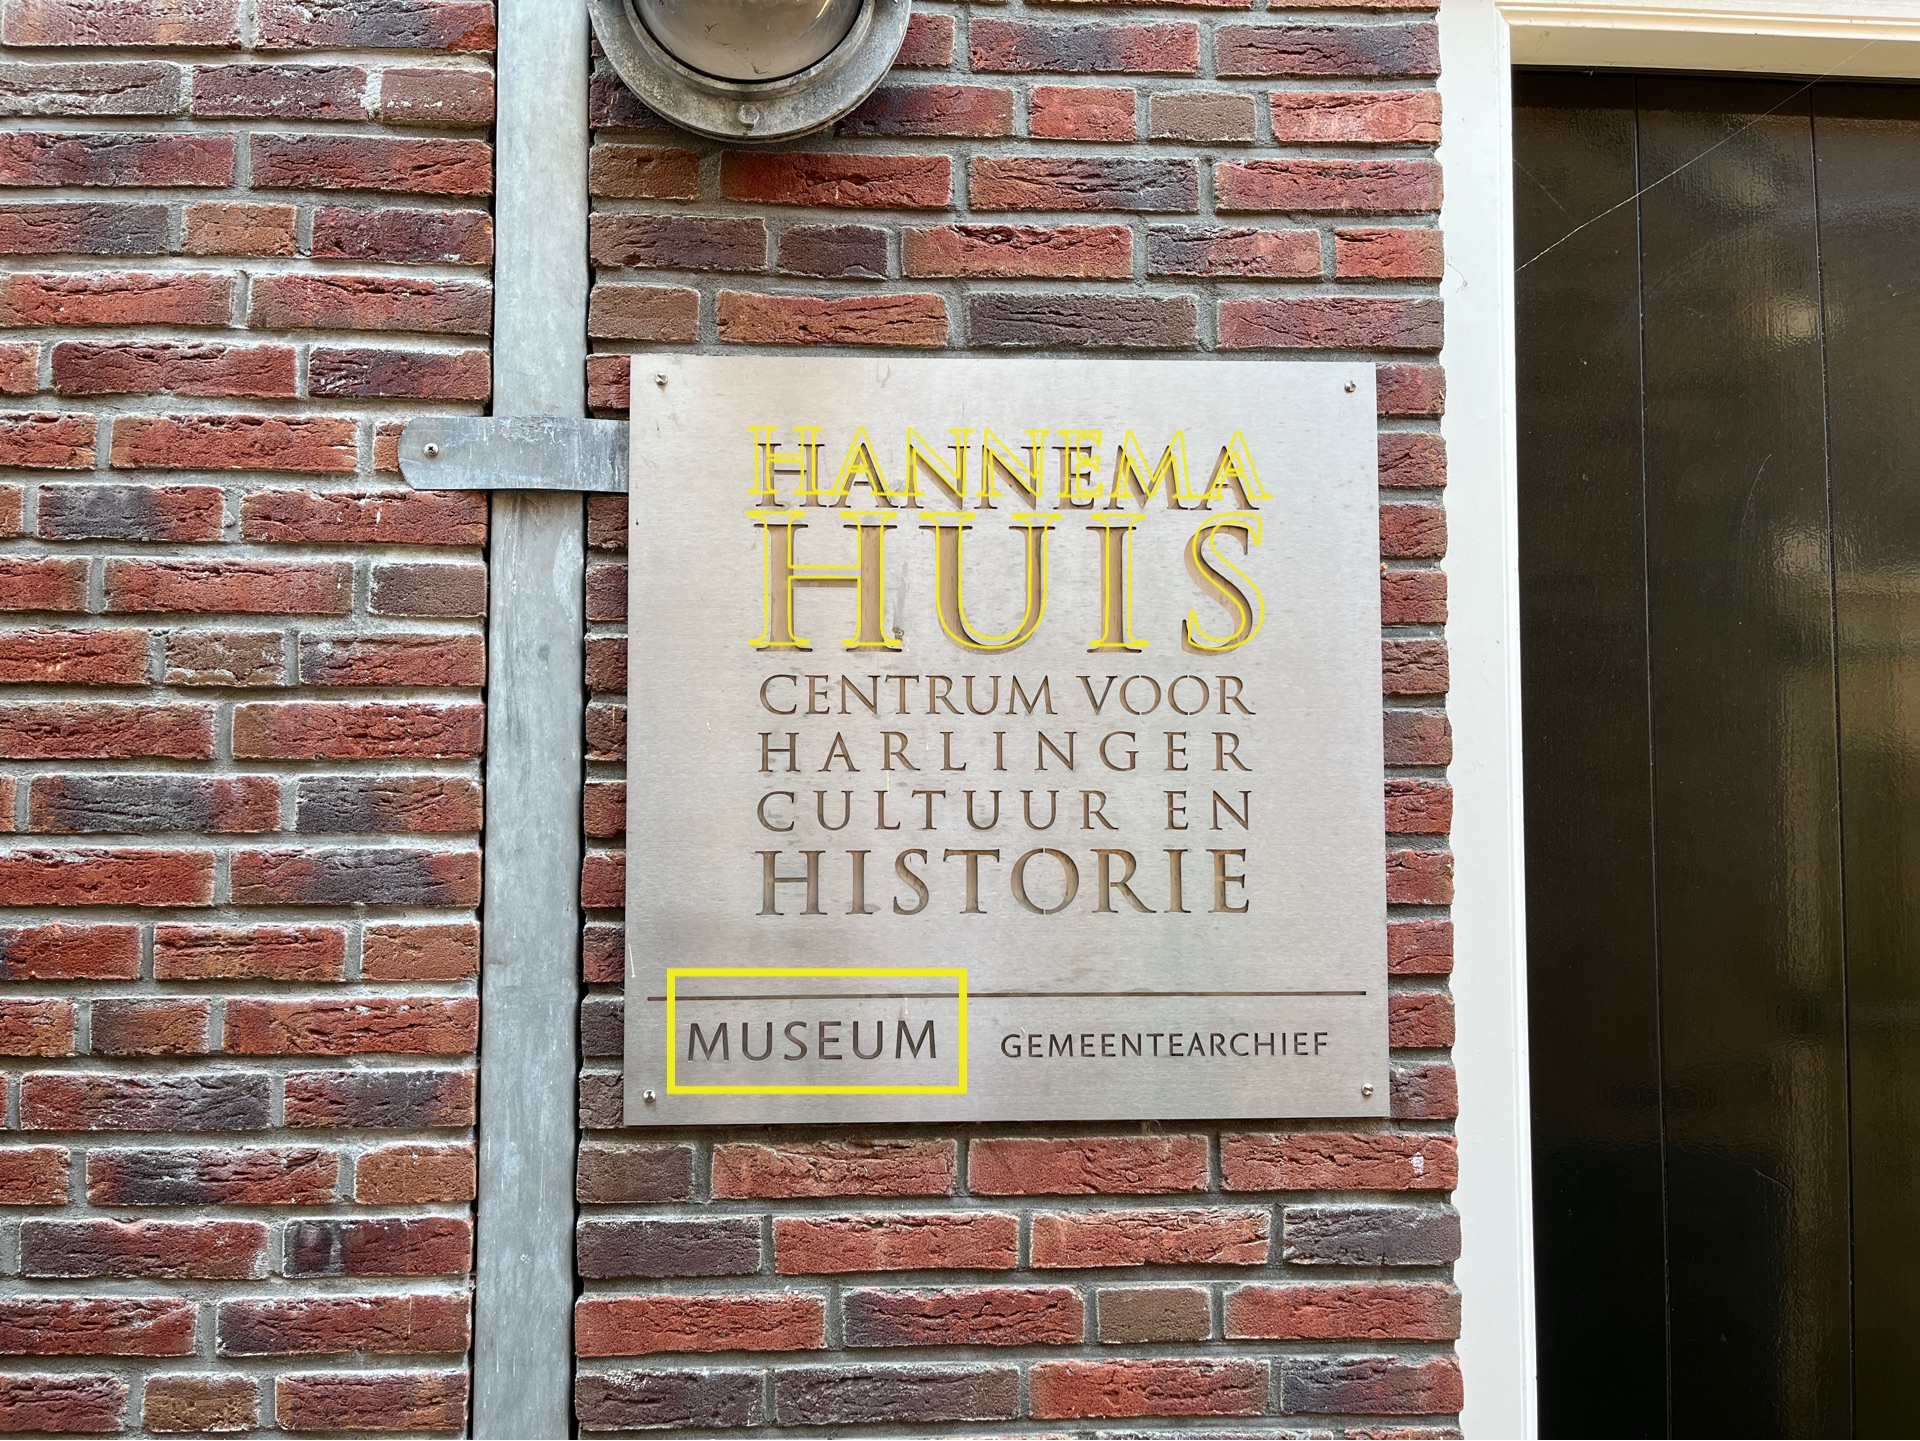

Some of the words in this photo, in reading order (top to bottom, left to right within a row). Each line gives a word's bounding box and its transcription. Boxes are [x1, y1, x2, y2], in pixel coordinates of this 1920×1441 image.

[746, 425, 1272, 511] HANNEMA
[746, 509, 1266, 655] HUIS
[758, 674, 1057, 716] CENTRUM
[1078, 674, 1256, 716] VOOR
[757, 731, 1253, 773] HARLINGER
[756, 789, 1119, 832] CULTUUR
[1165, 789, 1252, 831] EN
[755, 848, 1250, 916] HISTORIE
[686, 1019, 938, 1062] MUSEUM
[1000, 1031, 1329, 1059] GEMEENTEARCHIEF
